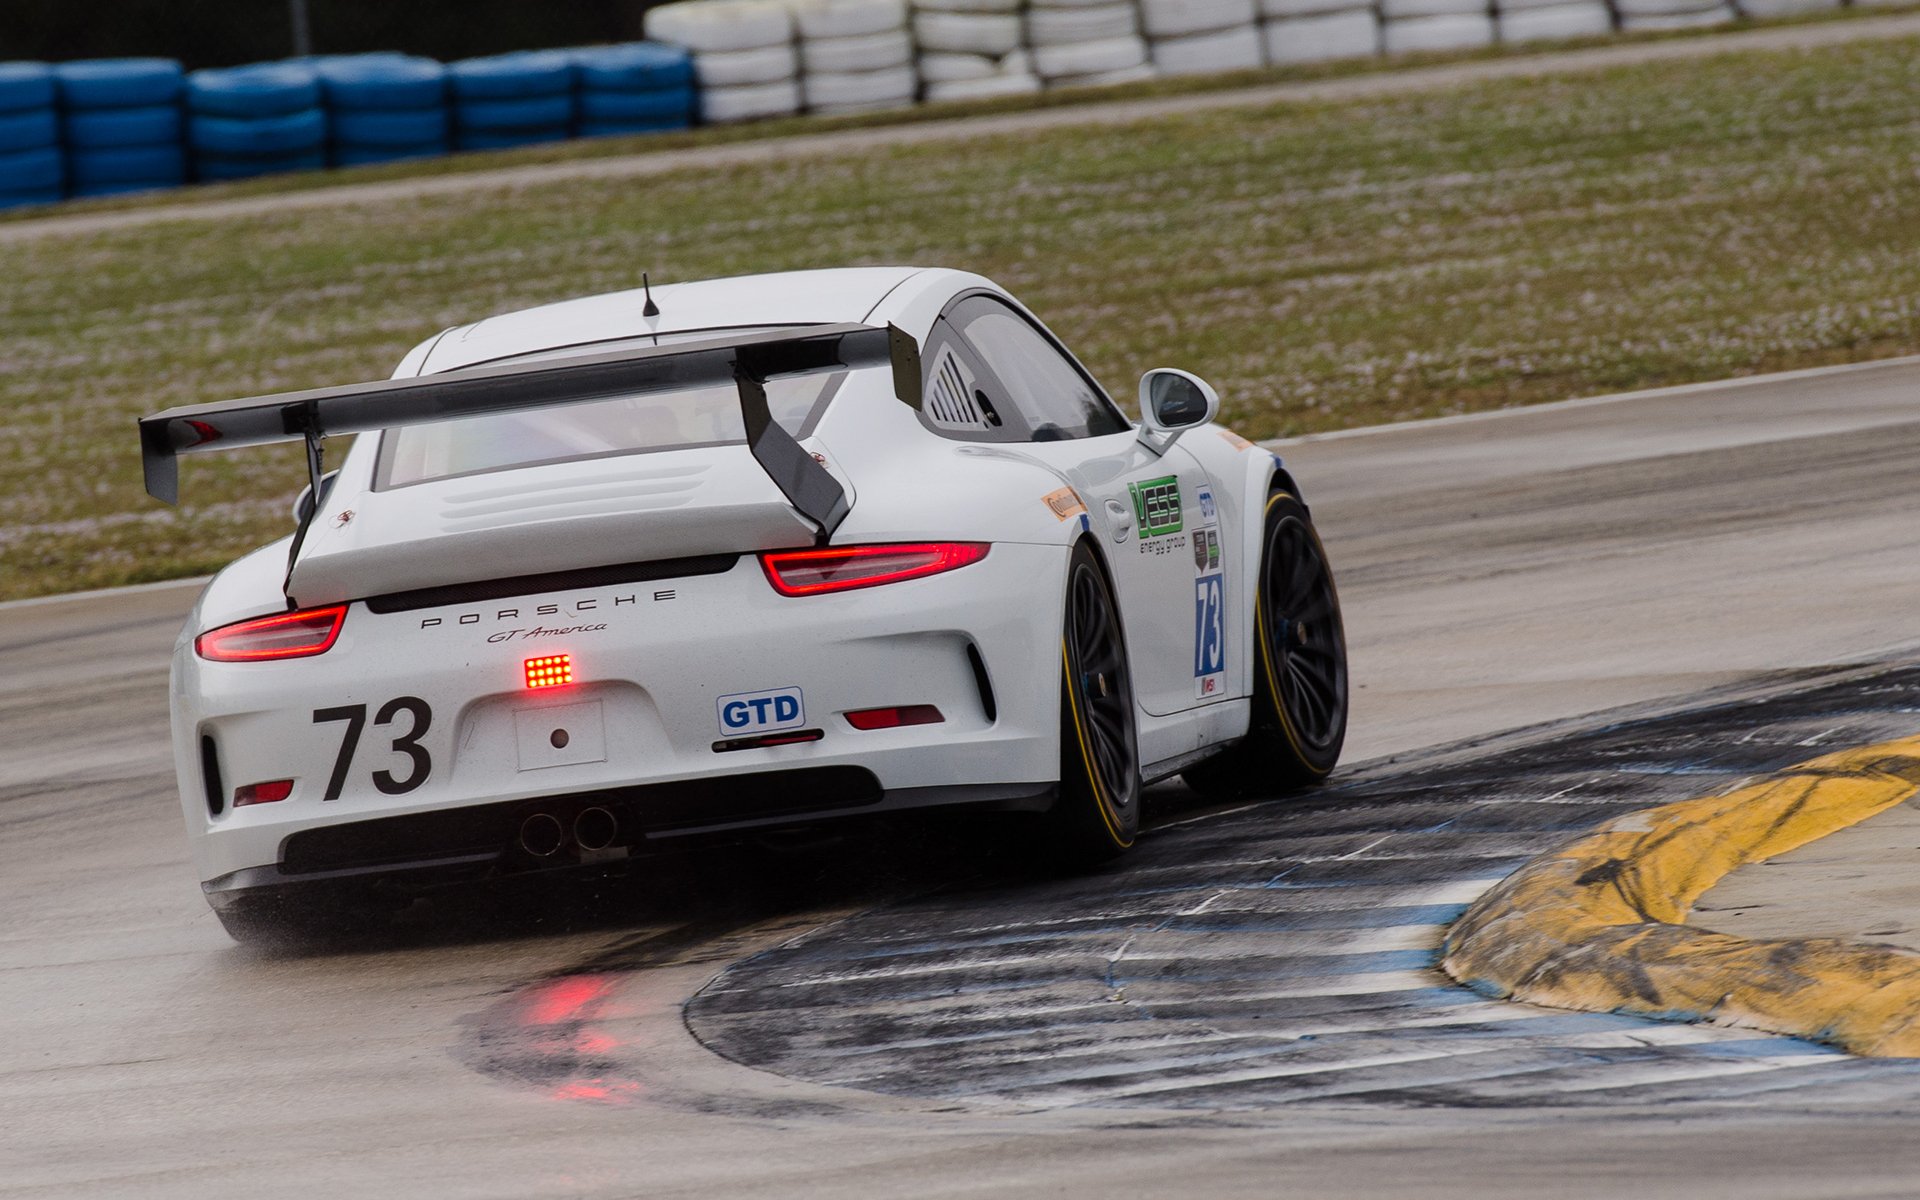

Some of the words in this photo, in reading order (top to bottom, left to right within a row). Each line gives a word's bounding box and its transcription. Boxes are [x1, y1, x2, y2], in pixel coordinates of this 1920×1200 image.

[1140, 540, 1165, 555] energy
[1166, 536, 1186, 553] group
[420, 589, 676, 629] PORSCHE
[1197, 579, 1221, 671] 73
[487, 629, 525, 644] GT
[521, 622, 608, 640] America
[723, 695, 799, 728] GTD
[312, 695, 432, 801] 73
